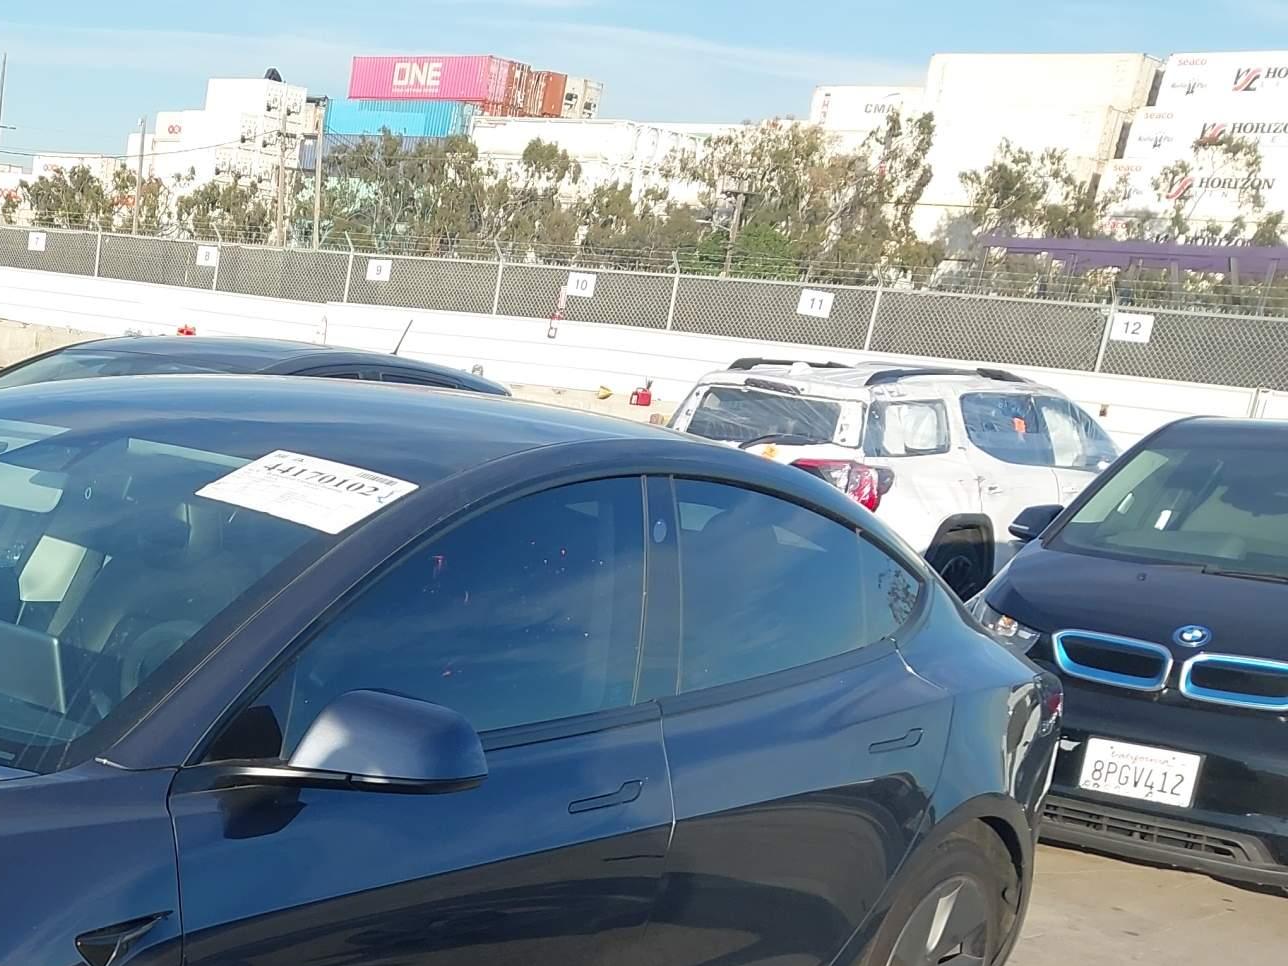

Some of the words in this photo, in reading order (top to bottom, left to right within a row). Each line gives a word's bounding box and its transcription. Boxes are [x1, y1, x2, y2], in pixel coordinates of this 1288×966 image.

[392, 61, 443, 87] ONE
[1198, 176, 1276, 190] HORIZON
[204, 251, 211, 262] 8
[374, 265, 383, 276] 9
[575, 279, 589, 291] 10
[808, 297, 825, 312] 11
[1124, 320, 1142, 336] 12
[263, 462, 380, 497] 44170102
[1090, 760, 1185, 797] 8PGV412
